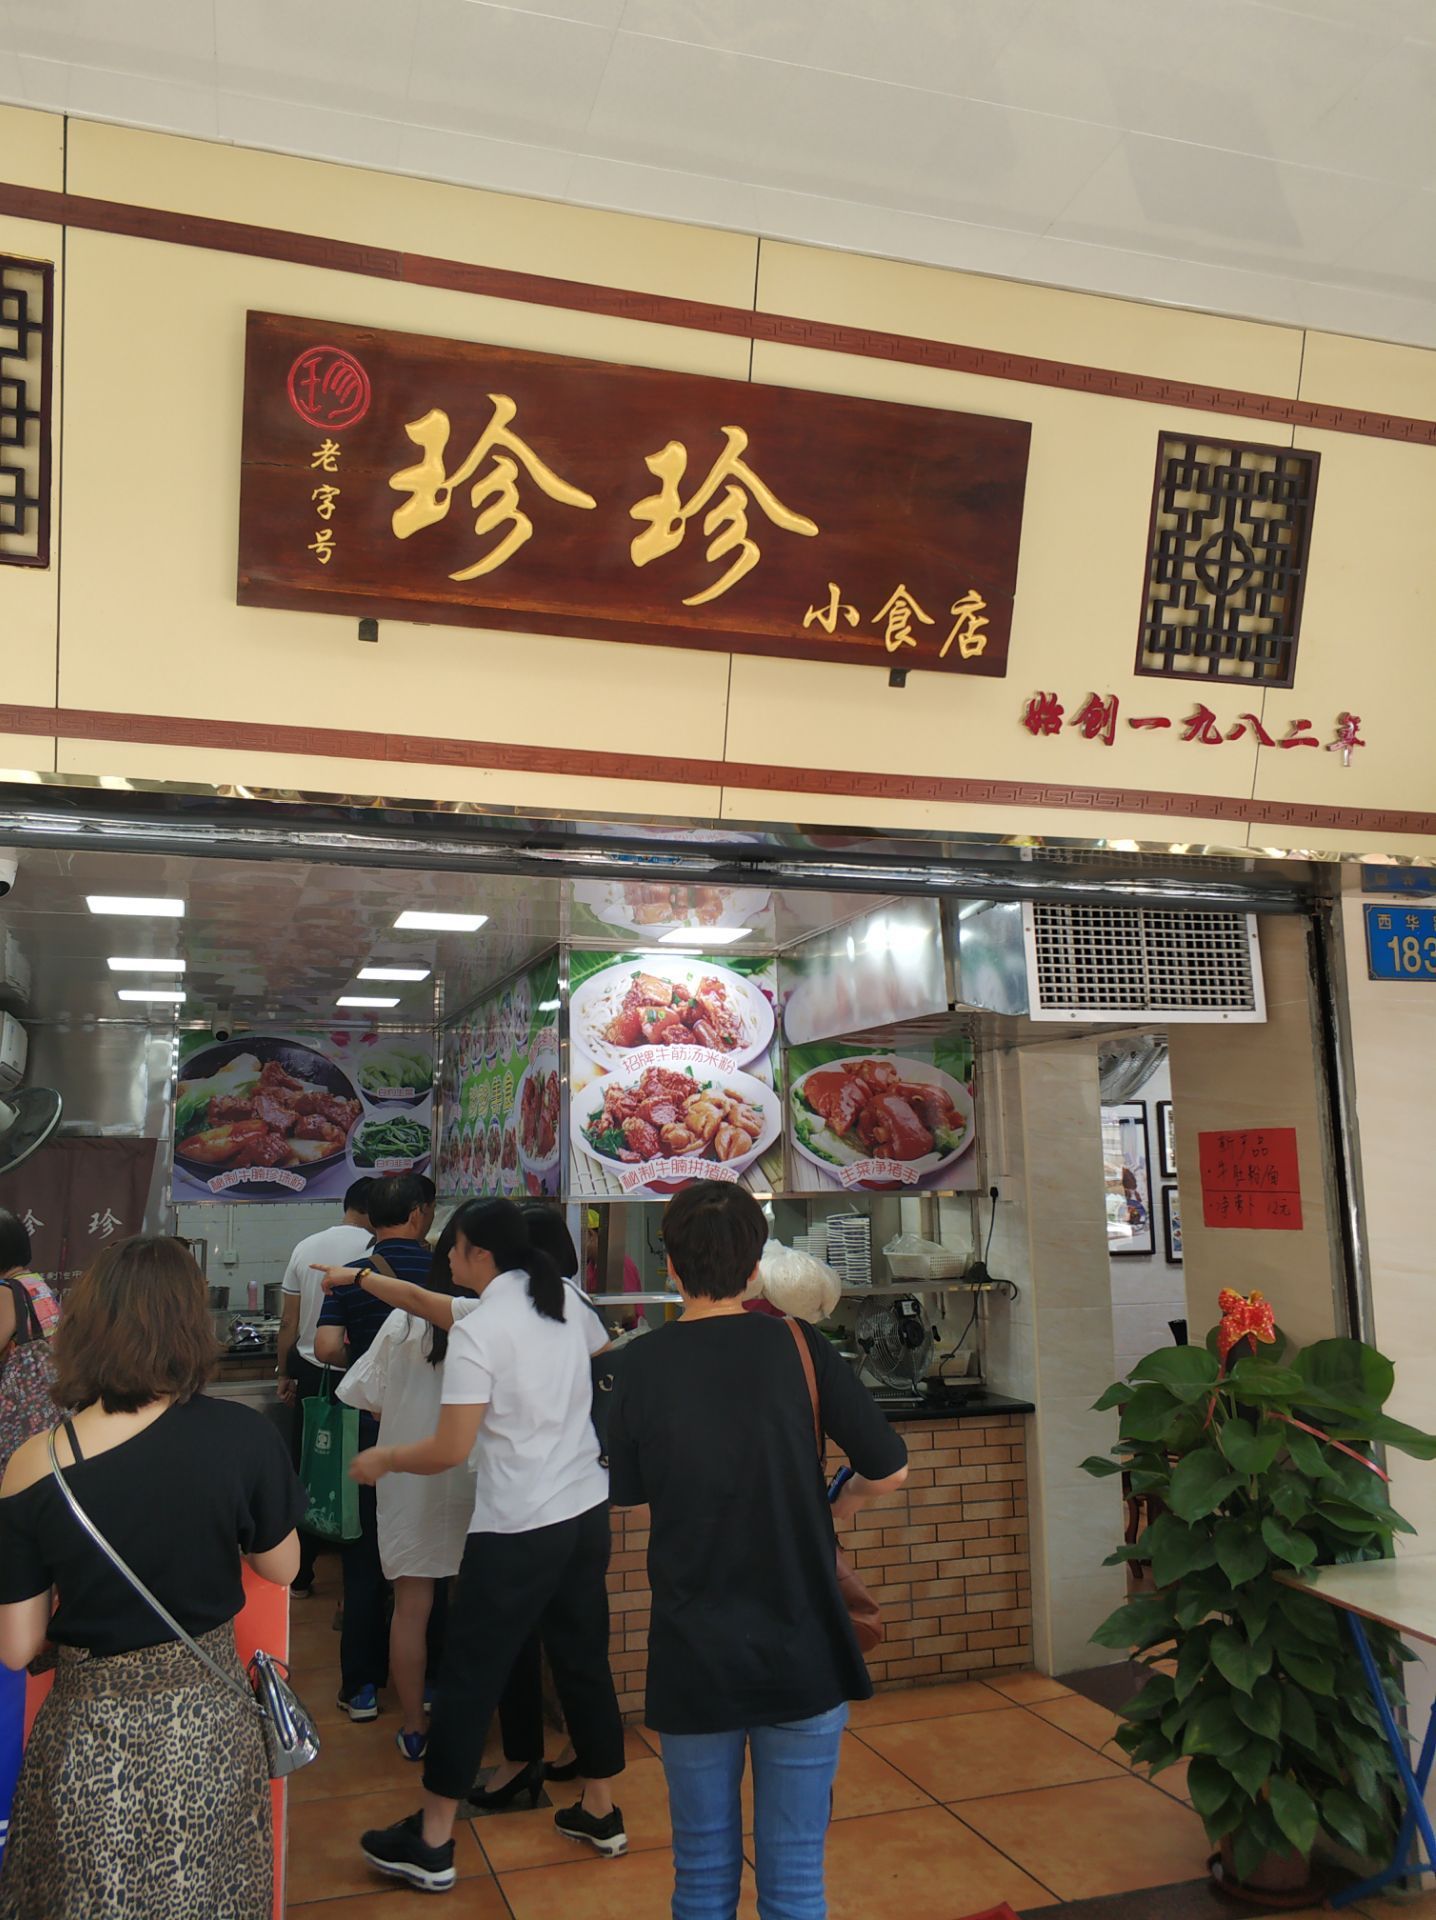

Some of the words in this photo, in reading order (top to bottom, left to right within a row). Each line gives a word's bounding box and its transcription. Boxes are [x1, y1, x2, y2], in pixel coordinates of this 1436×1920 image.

[307, 439, 343, 565] 老字号
[389, 393, 819, 606] 珍珍
[803, 582, 990, 660] 小食店
